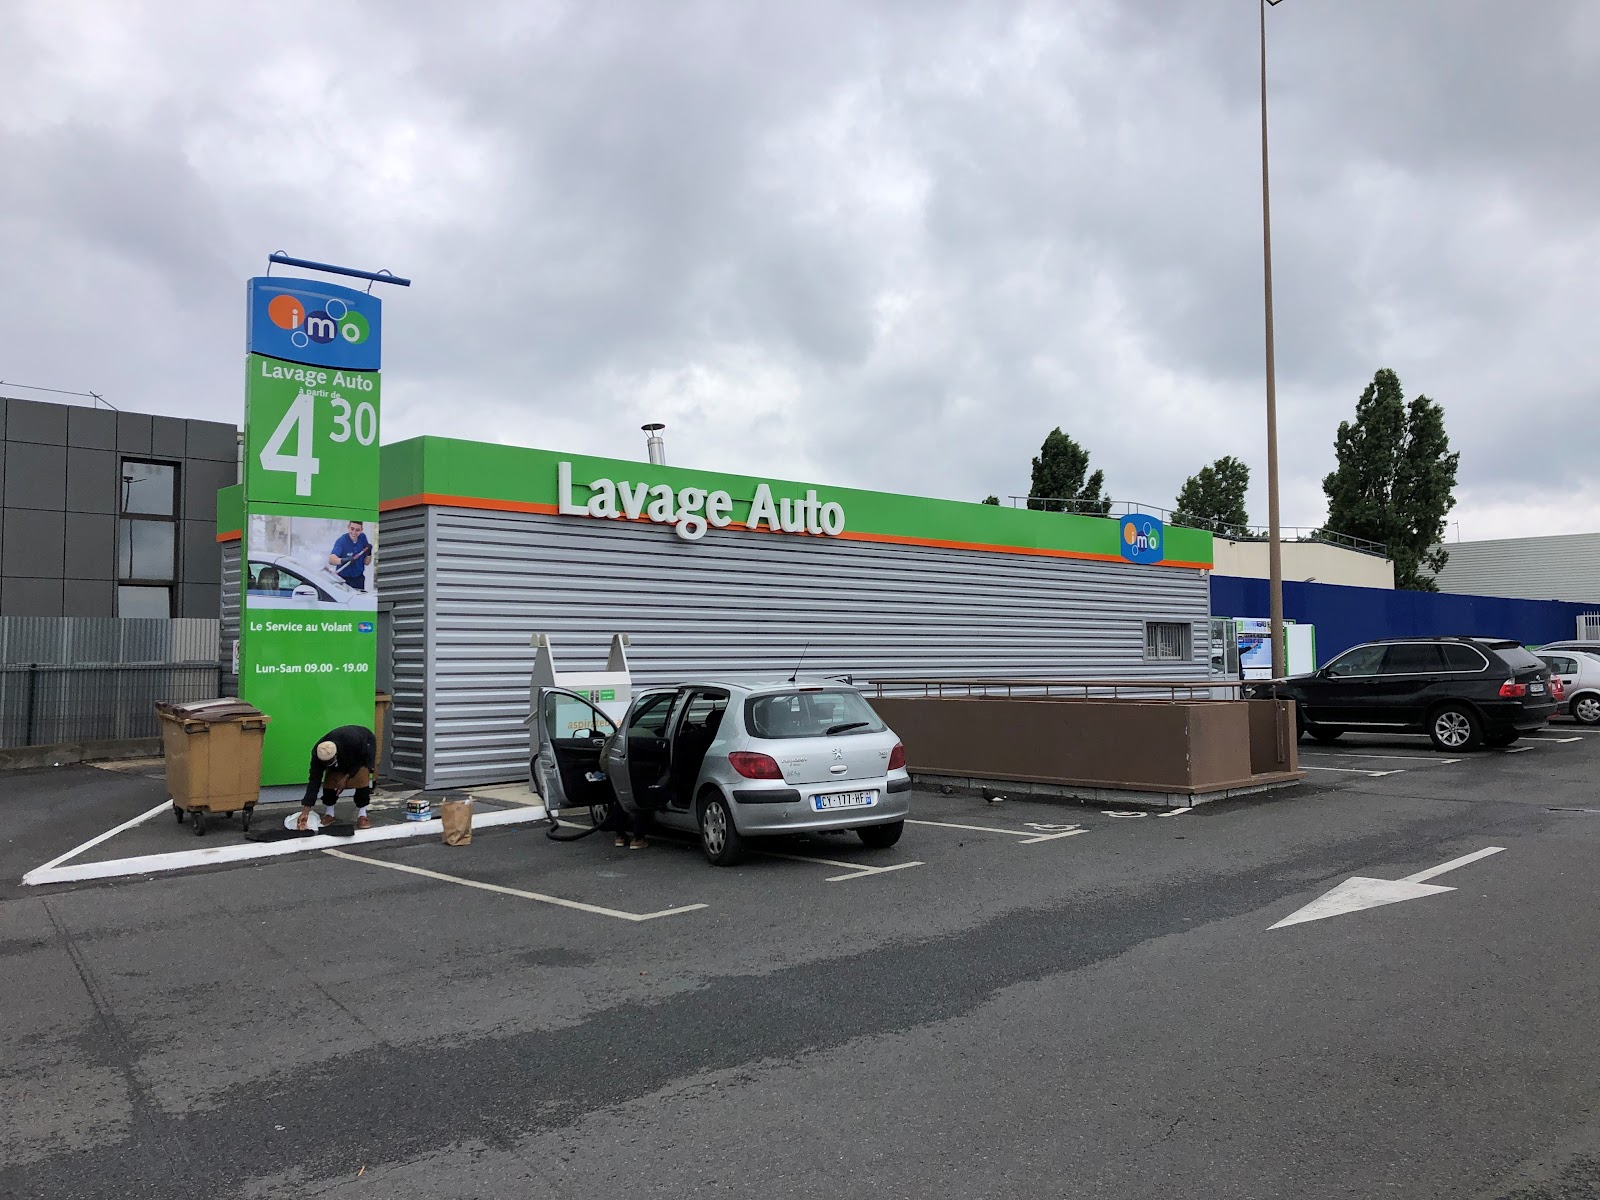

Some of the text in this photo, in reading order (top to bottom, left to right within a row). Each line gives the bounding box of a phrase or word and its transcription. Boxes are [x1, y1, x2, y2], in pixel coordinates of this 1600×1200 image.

[292, 309, 360, 343] imo
[261, 361, 373, 392] Lavage Auto
[306, 389, 329, 398] partir
[259, 393, 377, 496] 4 30
[558, 461, 845, 540] Lavage Auto
[1131, 531, 1157, 550] imo
[250, 621, 263, 632] Le
[265, 621, 303, 632] Service
[305, 623, 318, 632] au
[321, 622, 353, 632] Volant
[255, 663, 302, 674] Lun-Sam
[304, 663, 333, 673] 09.00
[342, 663, 369, 673] 19.00
